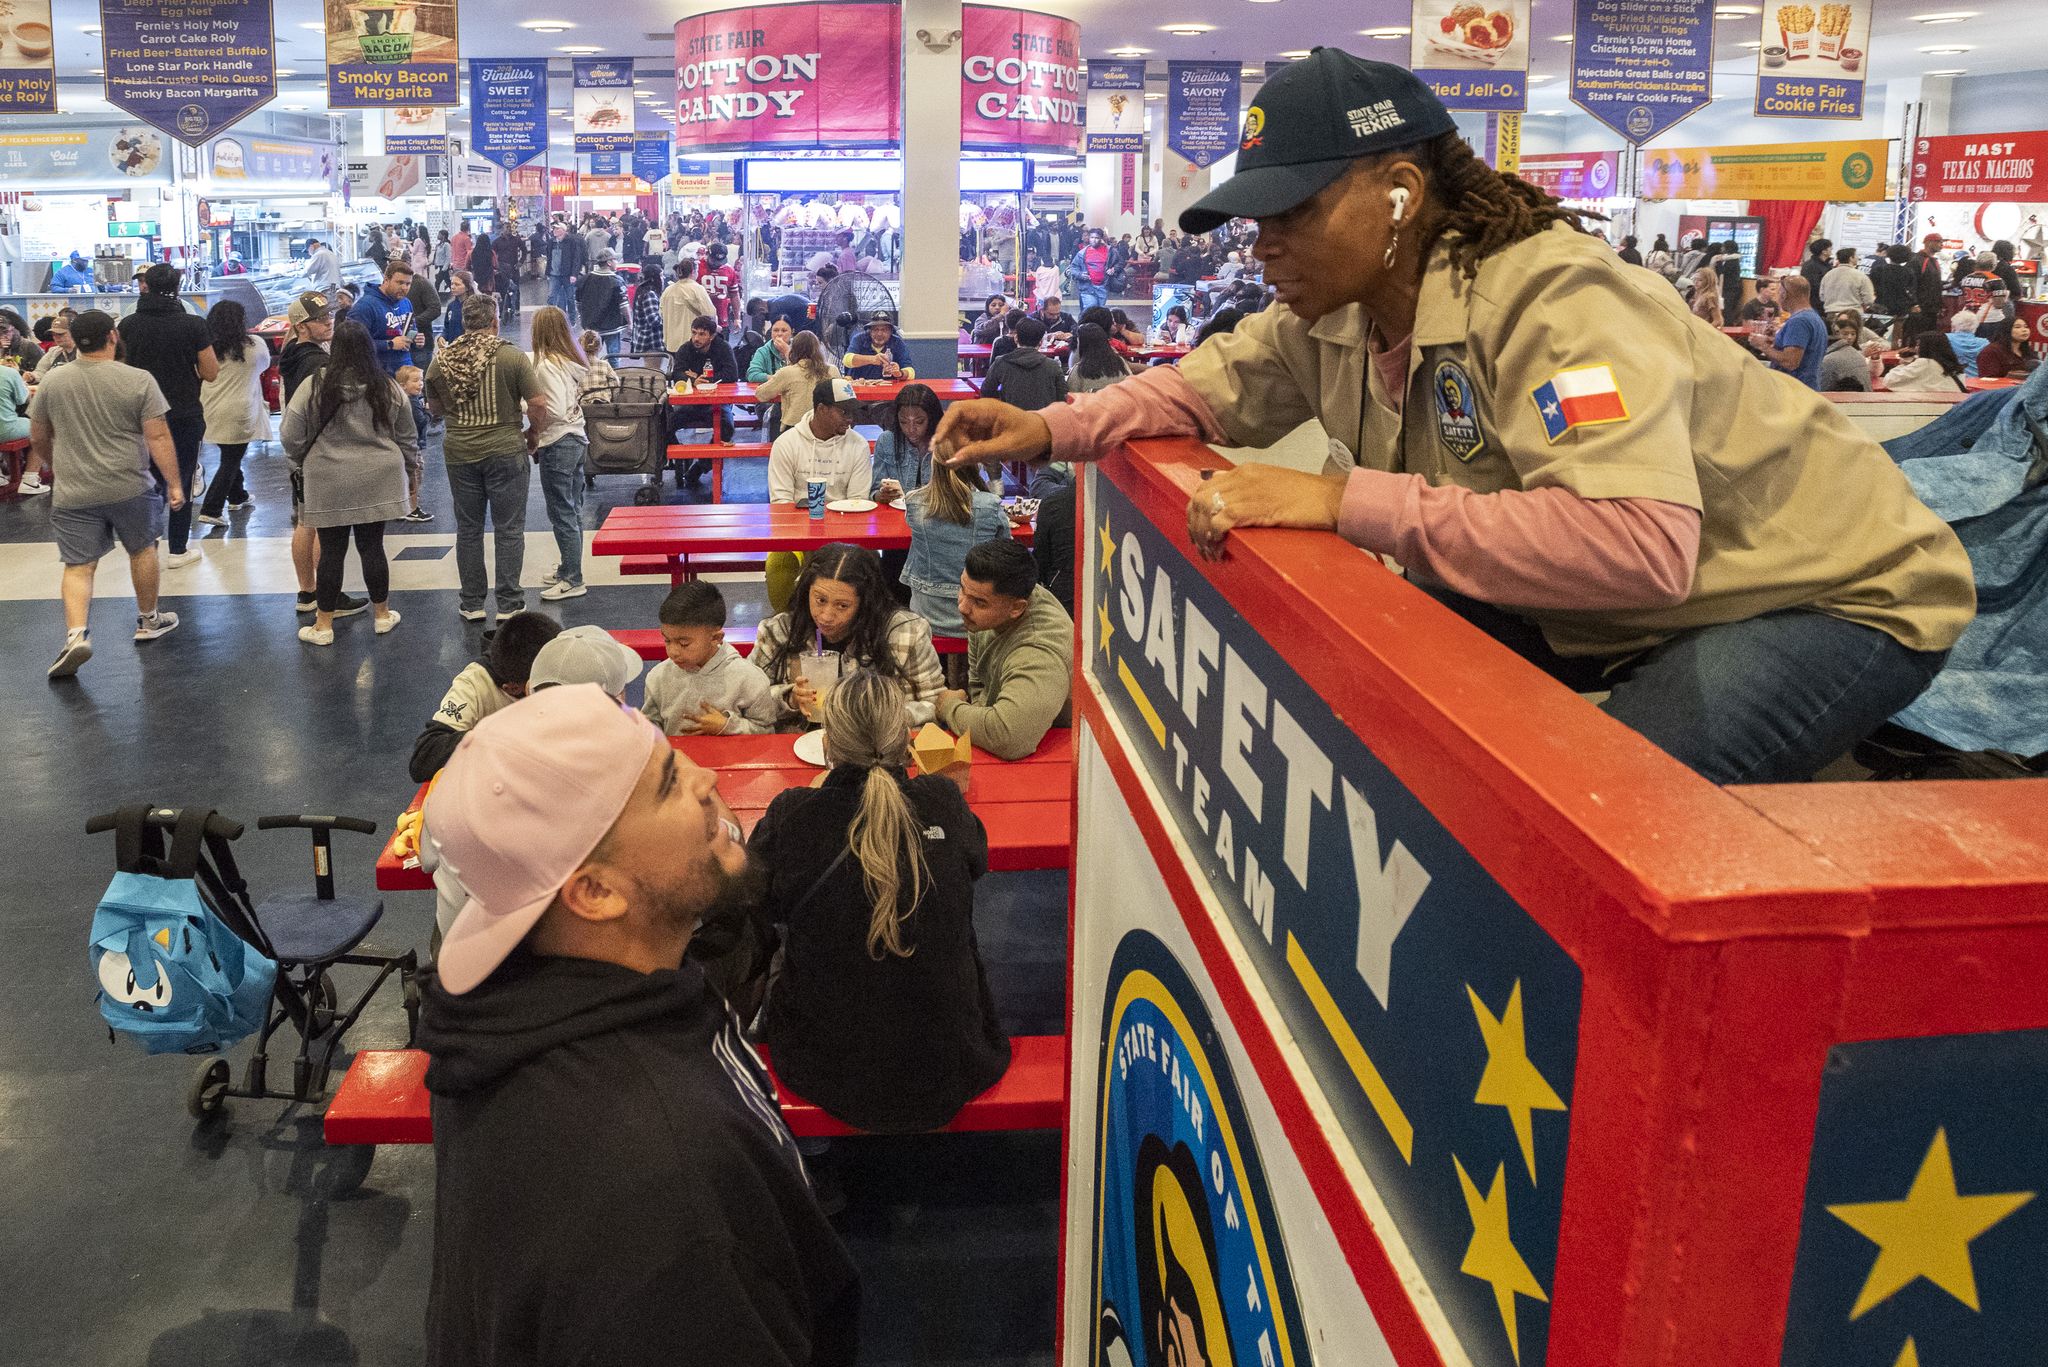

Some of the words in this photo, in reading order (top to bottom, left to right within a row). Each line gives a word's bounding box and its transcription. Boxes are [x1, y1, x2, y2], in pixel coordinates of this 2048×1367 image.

[160, 8, 184, 18] Egg
[188, 8, 213, 16] Nest
[1597, 1, 1618, 11] Dog
[1620, 2, 1649, 11] Slider
[1672, 4, 1696, 13] Stick
[136, 21, 180, 30] Fernie's
[184, 20, 210, 31] Holy
[212, 20, 240, 30] Moly
[1592, 14, 1618, 24] Deep
[1620, 14, 1647, 23] Fried
[1647, 15, 1677, 24] Pulled
[1680, 16, 1700, 26] Pork
[1661, 26, 1688, 36] Dings
[140, 34, 176, 44] Carrot
[180, 34, 208, 43] Cake
[211, 33, 236, 44] Roly
[690, 34, 722, 56] STATE
[728, 29, 766, 49] FAIR
[1597, 35, 1634, 45] Fernie's
[1637, 36, 1664, 46] Down
[1666, 37, 1692, 46] Home
[364, 42, 410, 54] BACON
[1012, 33, 1054, 54] STATE
[1056, 38, 1074, 58] FAIR
[1590, 44, 1629, 54] Chicken
[1631, 45, 1647, 54] Pot
[1649, 46, 1664, 55] Pie
[1666, 47, 1697, 56] Pocket
[110, 49, 140, 58] Fried
[144, 47, 223, 58] Beer-Battered
[226, 46, 268, 56] Buffalo
[126, 62, 155, 72] Lone
[158, 62, 182, 71] Star
[184, 61, 210, 70] Pork
[213, 60, 253, 70] Handle
[1615, 56, 1640, 66] Fried
[338, 70, 392, 86] Smoky
[398, 70, 449, 83] Bacon
[482, 68, 535, 82] Finalists
[677, 53, 821, 91] COTTON
[1181, 71, 1232, 83] Finalists
[1577, 68, 1624, 78] Injectable
[1626, 69, 1650, 79] Great
[1652, 70, 1674, 80] Balls
[1675, 71, 1685, 80] of
[1685, 71, 1706, 80] BBQ
[0, 79, 14, 92] ly
[18, 79, 51, 92] Moly
[113, 75, 199, 85] Pretzel-Crusted
[202, 74, 230, 84] Pollo
[232, 74, 268, 83] Queso
[488, 86, 530, 96] SWEET
[1427, 82, 1460, 97] ied
[1577, 80, 1614, 89] Southern
[1614, 80, 1634, 90] Fried
[1634, 81, 1664, 90] Chicken
[1664, 82, 1671, 90] &
[1671, 82, 1706, 92] Dumplins
[1775, 82, 1815, 97] State
[1818, 84, 1848, 98] Fair
[0, 92, 12, 102] ke
[16, 92, 47, 104] Roly
[124, 89, 162, 99] Smoky
[166, 88, 201, 98] Bacon
[204, 86, 259, 98] Margarita
[354, 85, 433, 101] Margarita
[1182, 88, 1227, 97] SAVORY
[1588, 92, 1614, 101] State
[1616, 92, 1635, 102] Fair
[1636, 93, 1669, 103] Cookie
[1670, 94, 1693, 104] Fries
[678, 90, 804, 124] CANDY
[1346, 106, 1374, 120] STATE
[1373, 100, 1394, 112] FAIR
[1764, 98, 1816, 112] Cookie
[1820, 100, 1855, 113] Fries
[606, 136, 633, 144] Candy
[1510, 116, 1518, 154] CRUNCH
[1964, 142, 2016, 156] HAST
[1942, 160, 1980, 180] TEXAS
[1985, 158, 2035, 180] NACHOS
[701, 274, 729, 300] 85
[1120, 532, 1432, 1012] SAFETY
[1172, 731, 1276, 946] TEAM
[1118, 1022, 1156, 1081] STATE
[1160, 1038, 1204, 1145] FAIR
[1211, 1150, 1240, 1232] OF
